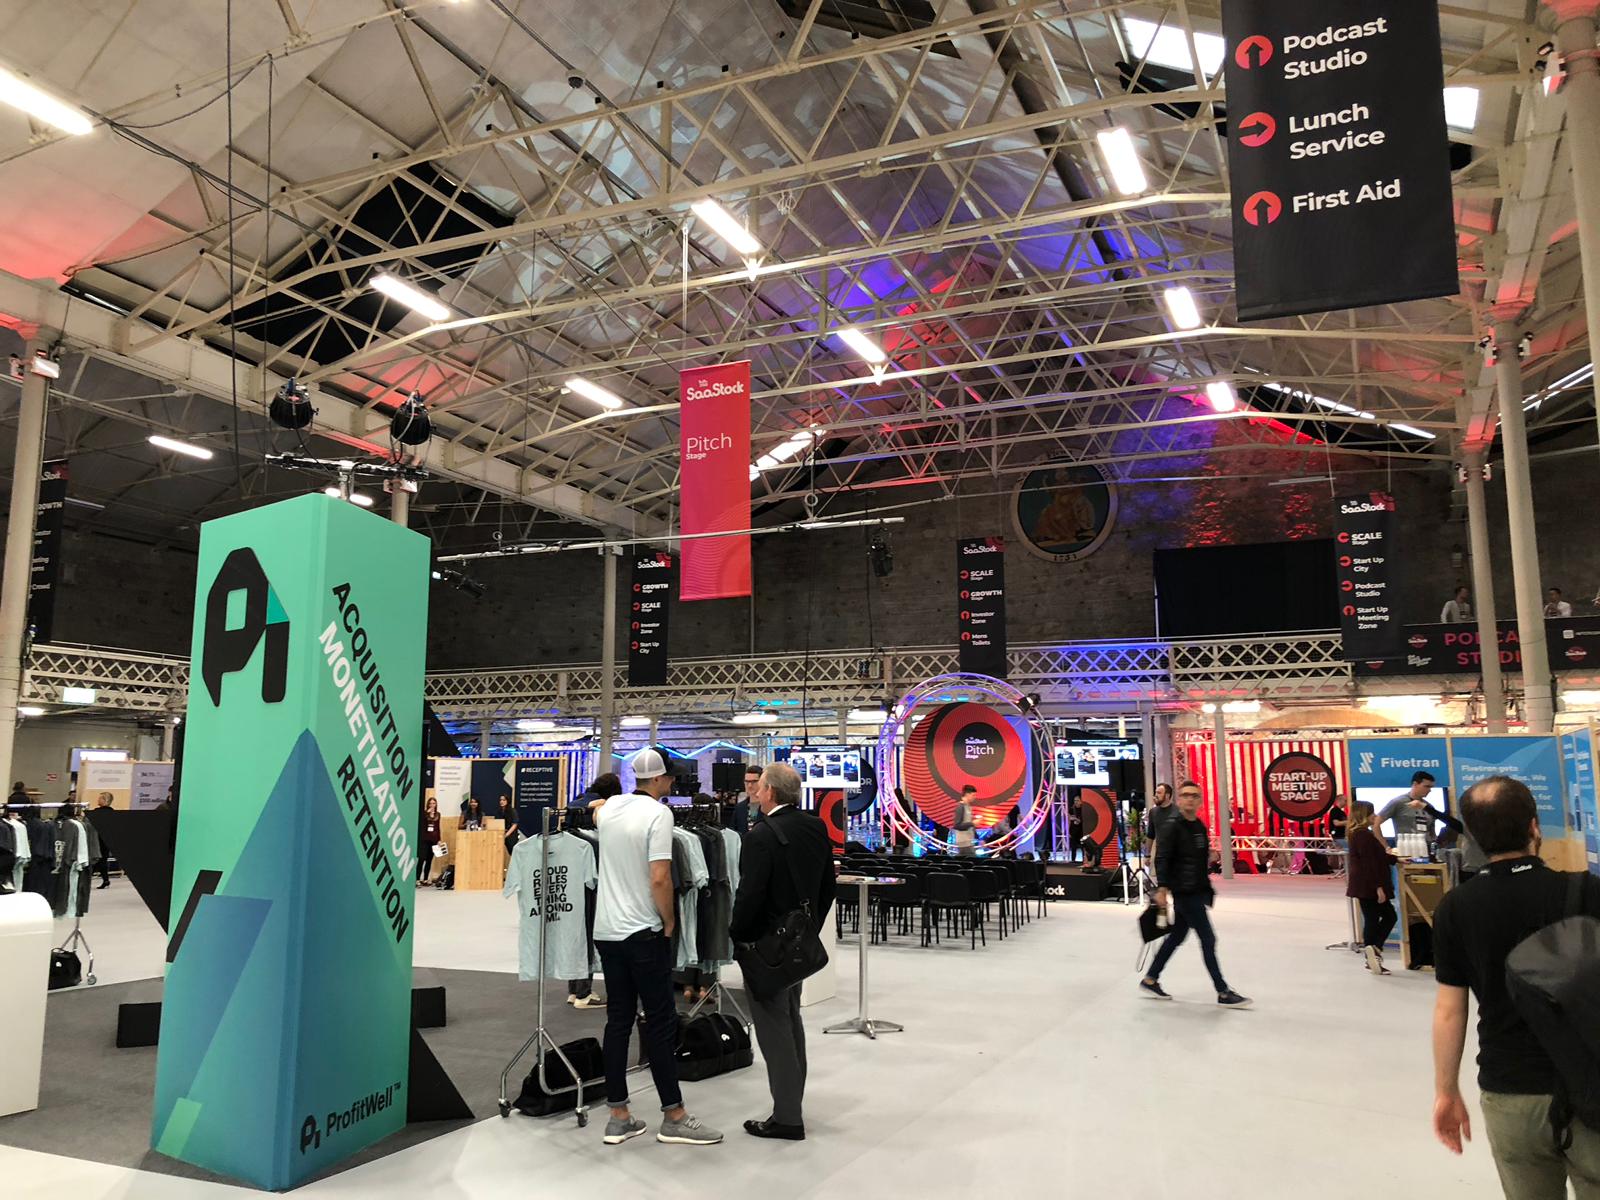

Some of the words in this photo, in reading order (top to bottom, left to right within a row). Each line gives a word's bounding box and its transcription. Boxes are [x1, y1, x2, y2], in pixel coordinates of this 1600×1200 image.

[1283, 17, 1388, 54] Podcast
[1283, 48, 1367, 81] Studio
[1289, 103, 1369, 134] Lunch
[1290, 128, 1386, 160] Service
[1292, 186, 1350, 213] First
[1355, 179, 1401, 203] Aid
[686, 381, 744, 401] SaaStock
[687, 433, 732, 453] Pitch
[686, 452, 707, 460] Stage
[1340, 502, 1385, 514] SaaStock
[1351, 532, 1382, 541] SCALE
[963, 545, 997, 555] SaaStock
[637, 560, 665, 569] SaaStock
[1353, 557, 1371, 565] Start
[1373, 557, 1384, 565] Up
[970, 569, 994, 577] SCALE
[1355, 582, 1386, 590] Podcast
[970, 589, 1002, 597] GROWTH
[1355, 590, 1381, 598] Studio
[1357, 606, 1376, 614] Start
[1376, 606, 1388, 614] Up
[1358, 614, 1390, 622] Meeting
[1358, 622, 1378, 630] Zone
[332, 582, 415, 801] ACQUISITION
[318, 621, 416, 883] MONETIZATION
[966, 745, 994, 755] Pitch
[1380, 757, 1440, 768] Fivetran
[1269, 772, 1328, 782] START-UP
[1272, 782, 1326, 791] MEETING
[1280, 792, 1319, 801] SPACE
[336, 754, 410, 944] RETENTION
[533, 866, 568, 878] COUD
[533, 875, 567, 888] RLES
[534, 884, 567, 896] EERY
